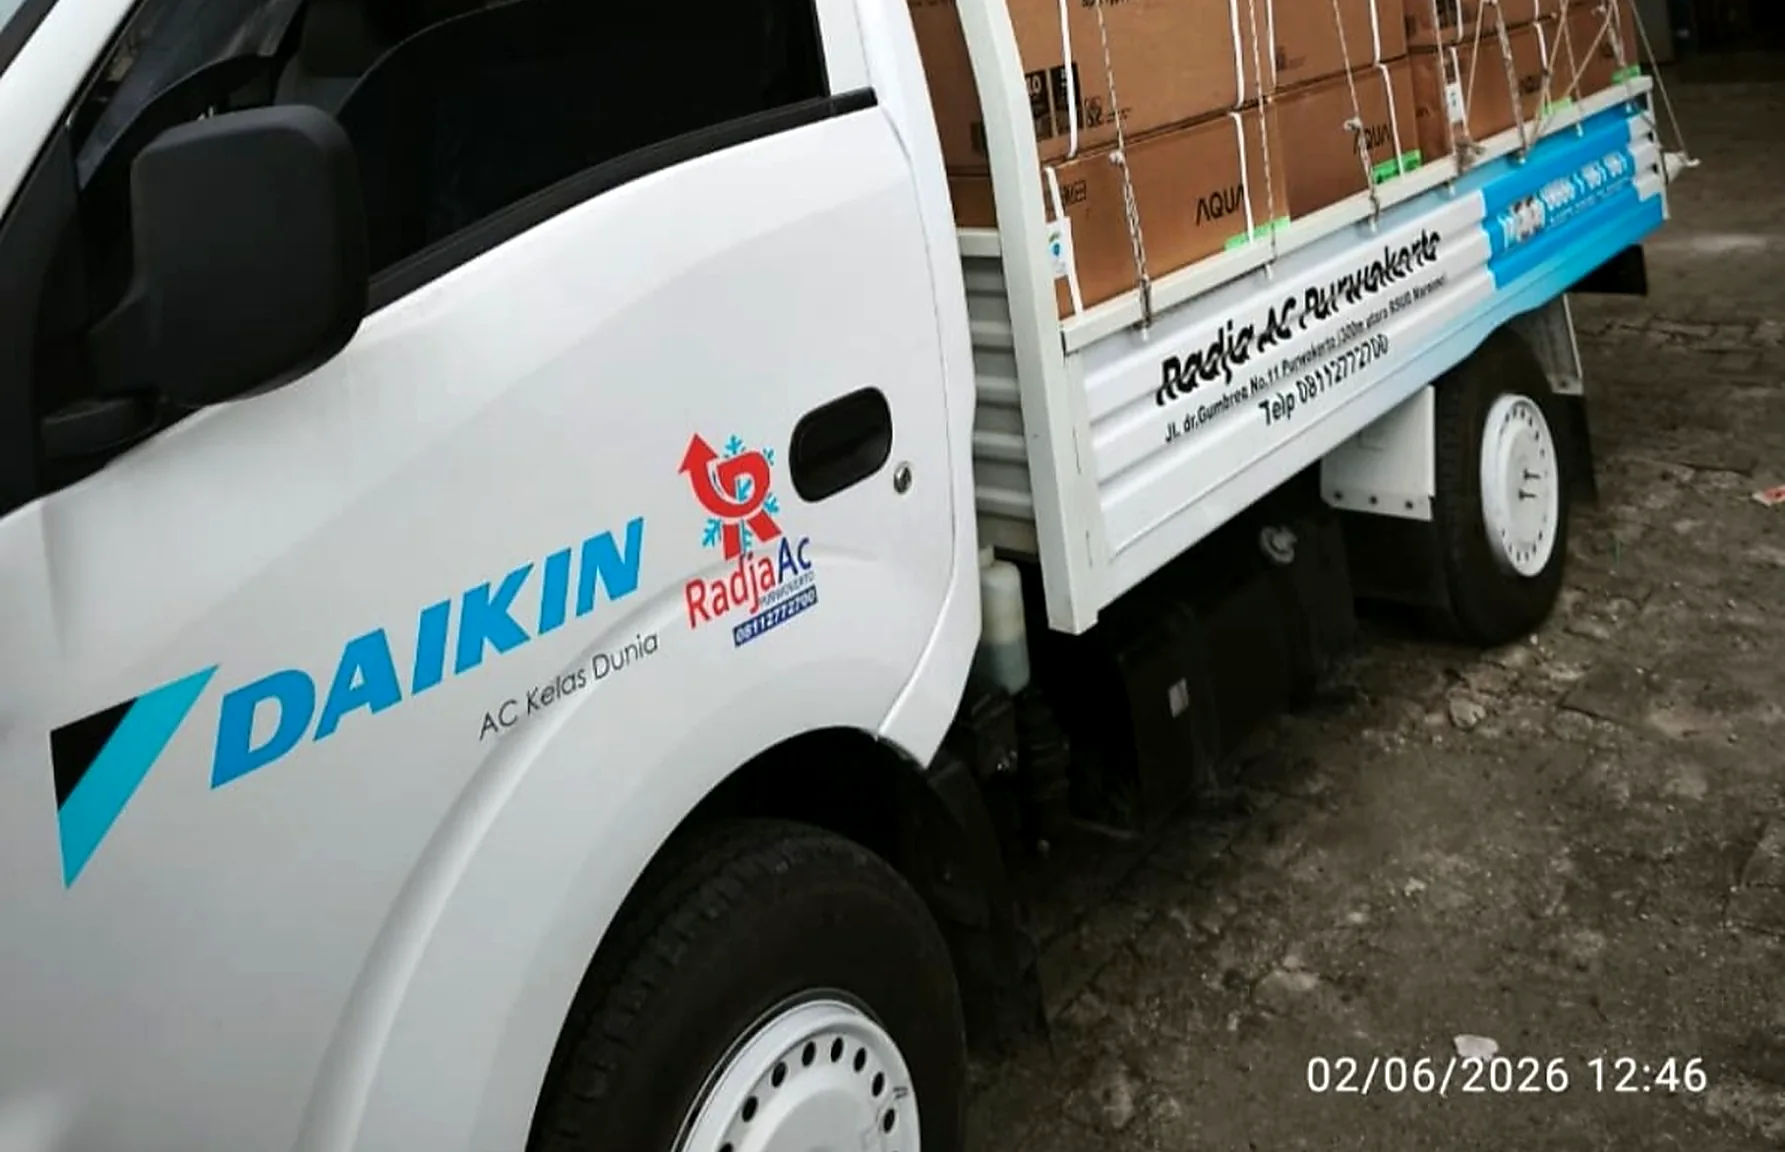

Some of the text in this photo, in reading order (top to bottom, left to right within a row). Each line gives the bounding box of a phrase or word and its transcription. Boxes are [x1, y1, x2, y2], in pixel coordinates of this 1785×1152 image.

[1195, 184, 1246, 227] AQUA
[1156, 320, 1254, 406] Radja
[1257, 297, 1297, 353] AC
[1258, 333, 1389, 426] Telp 08112772700
[209, 516, 645, 791] DAIKIN
[479, 633, 660, 742] AC Kelas Dunia
